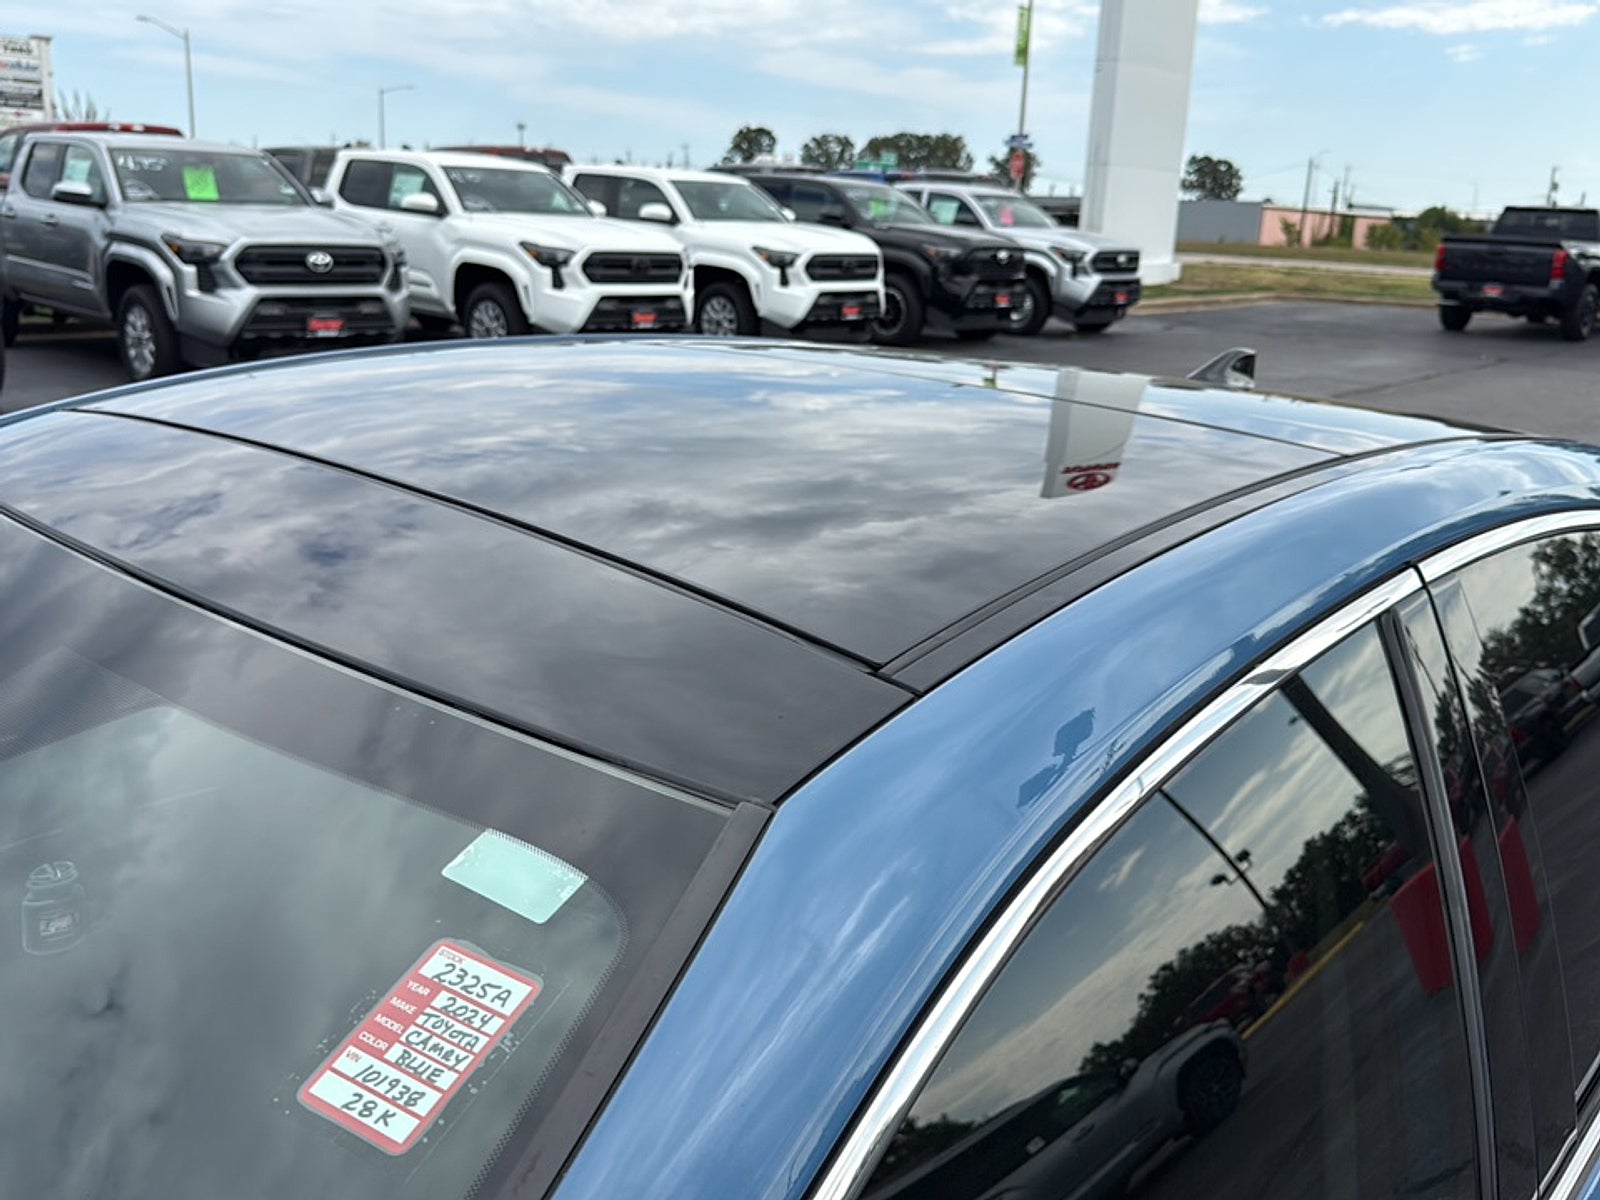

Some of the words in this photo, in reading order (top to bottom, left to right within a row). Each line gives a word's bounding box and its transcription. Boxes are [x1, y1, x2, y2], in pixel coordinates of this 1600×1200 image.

[438, 950, 465, 964] STOCK
[407, 979, 431, 997] YEAR
[440, 996, 494, 1030] 2024
[431, 963, 513, 1008] 2325A
[374, 1013, 403, 1034] MODEL
[405, 1029, 469, 1070] CAMRY
[390, 996, 418, 1014] MAKE
[421, 1011, 480, 1054] TOYOTA
[345, 1050, 361, 1063] VIN
[357, 1030, 389, 1051] COLOR
[394, 1048, 445, 1084] BLUE
[353, 1064, 426, 1108] 101938
